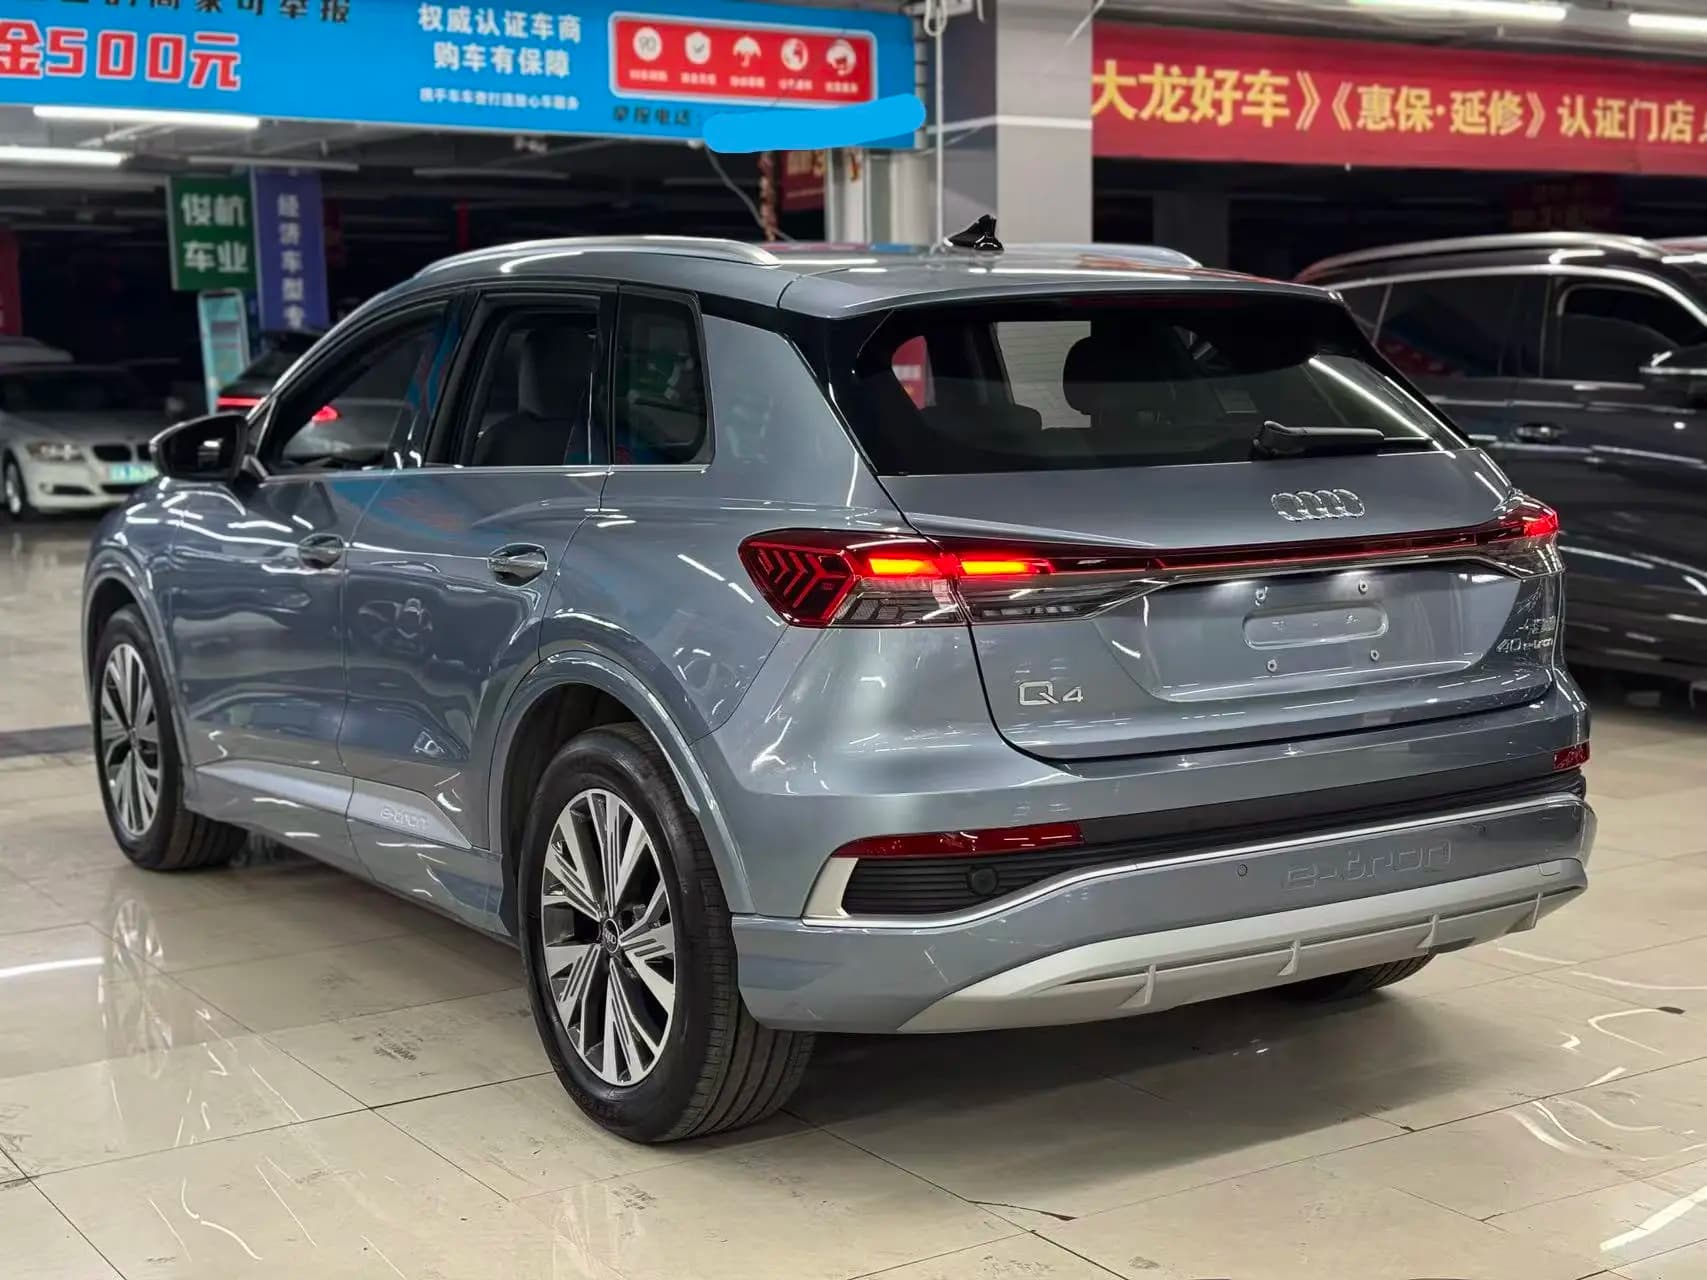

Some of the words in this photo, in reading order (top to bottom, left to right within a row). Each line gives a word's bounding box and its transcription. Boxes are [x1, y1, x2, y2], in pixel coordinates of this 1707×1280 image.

[417, 2, 582, 44] 权威认证车商
[0, 18, 241, 91] 金500元
[433, 41, 571, 79] 购车有保障
[182, 241, 249, 274] 车业
[1018, 680, 1084, 706] Q4
[1281, 839, 1456, 891] e-tron
